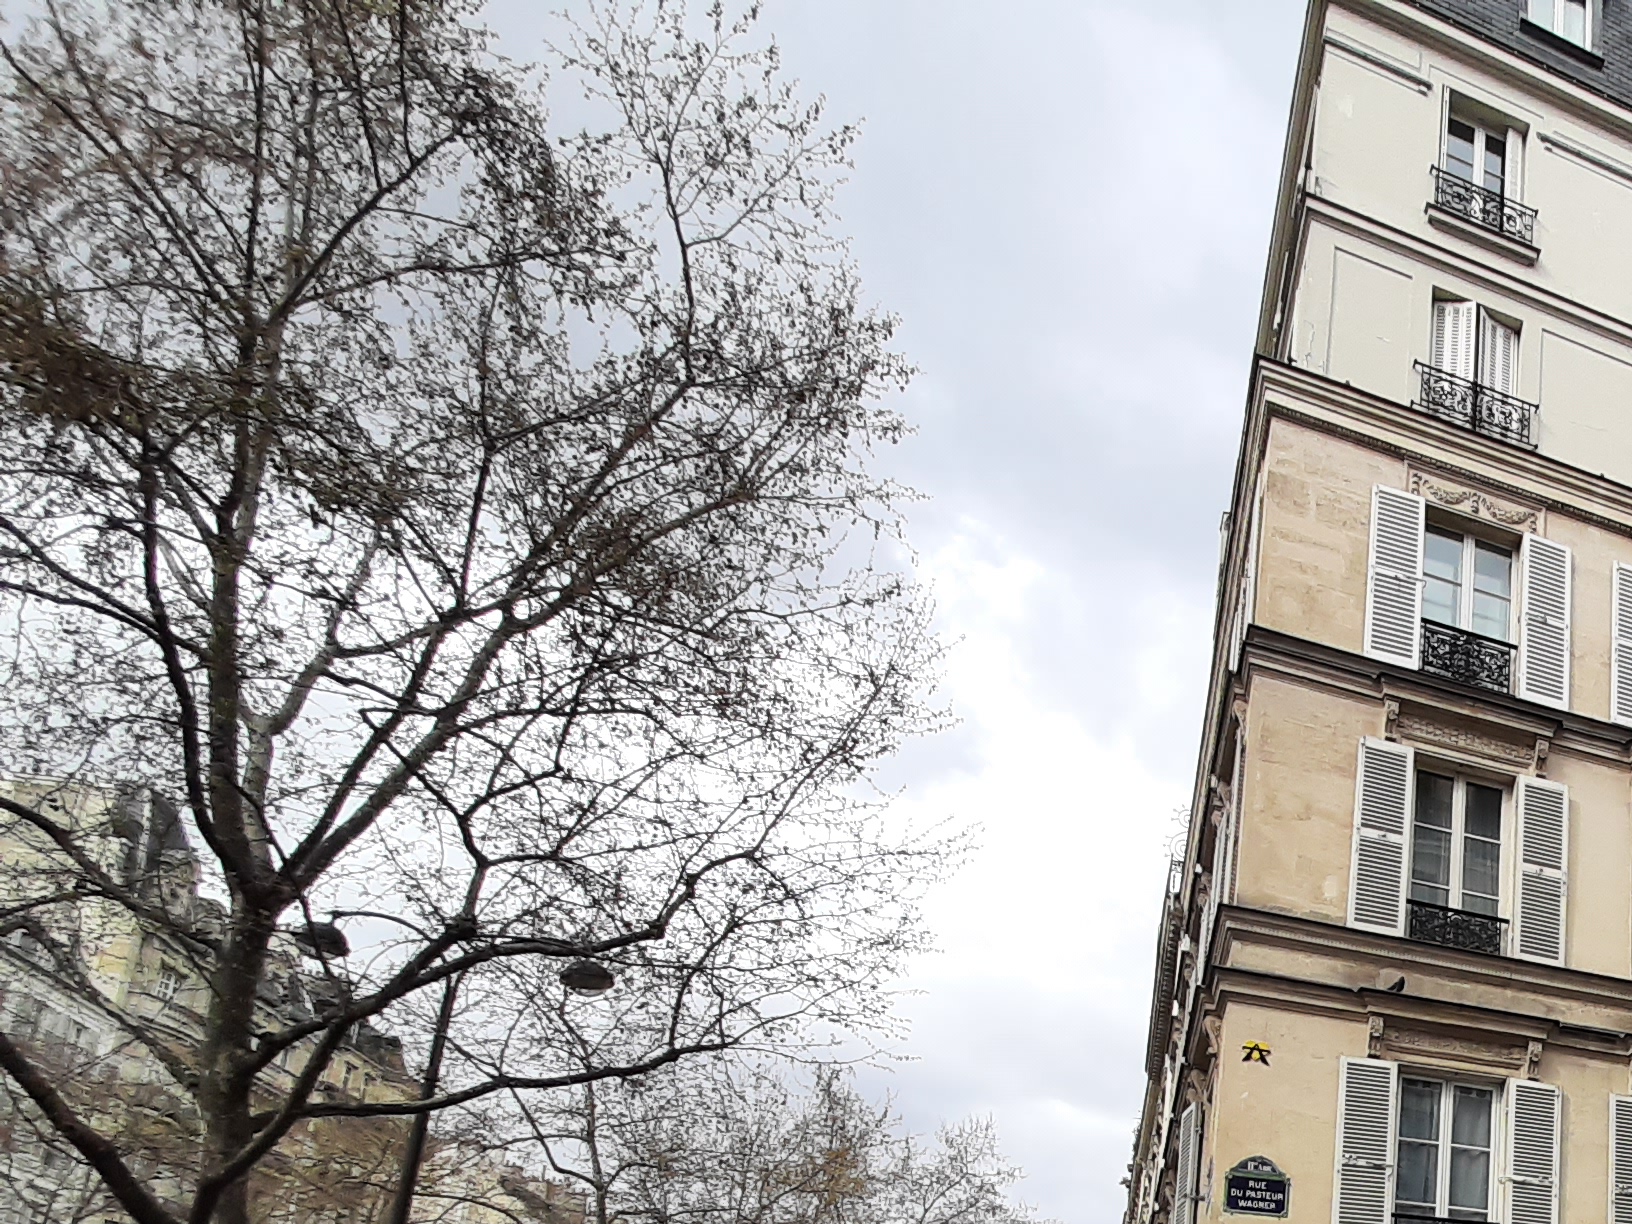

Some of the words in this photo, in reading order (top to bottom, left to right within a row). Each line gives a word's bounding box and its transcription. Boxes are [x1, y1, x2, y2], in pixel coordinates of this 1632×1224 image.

[1248, 1180, 1267, 1190] RUE
[1230, 1187, 1243, 1197] DU
[1245, 1189, 1284, 1201] PASTEUR
[1237, 1198, 1277, 1210] WAGNER
